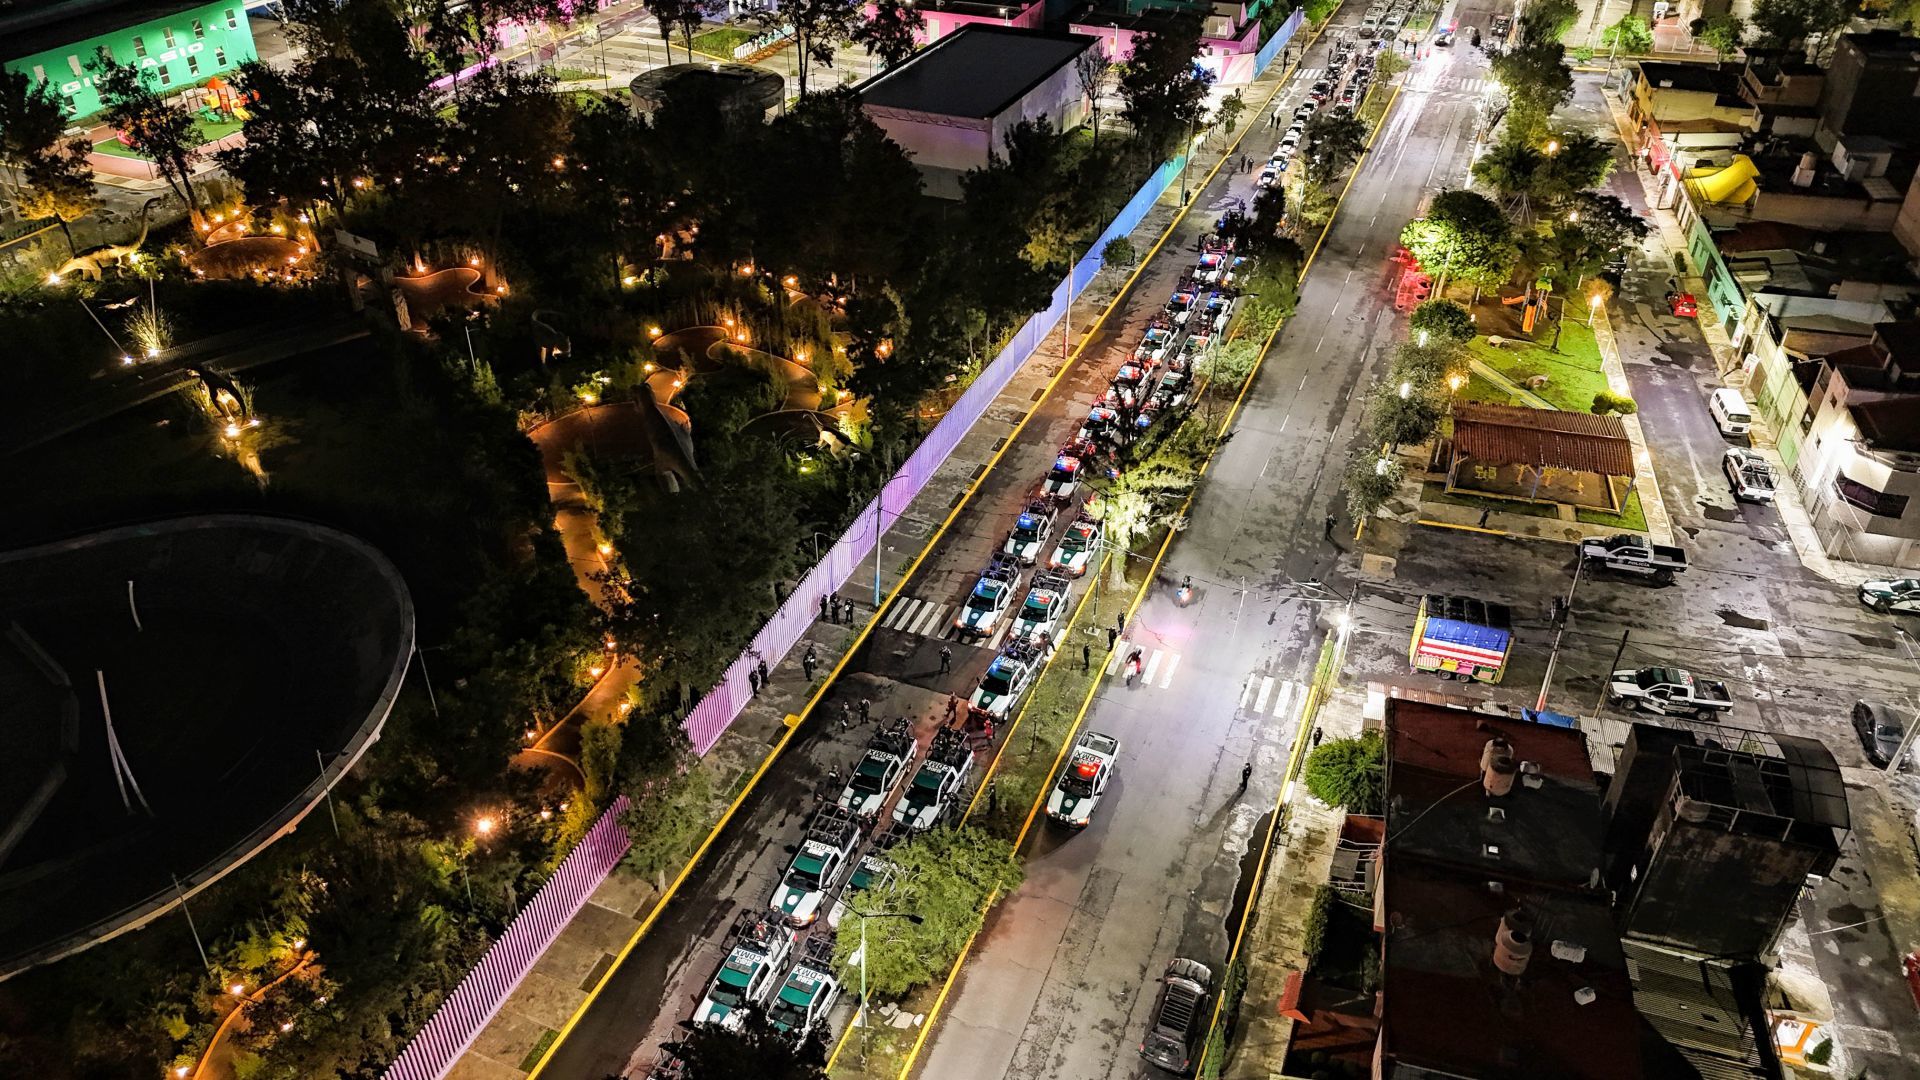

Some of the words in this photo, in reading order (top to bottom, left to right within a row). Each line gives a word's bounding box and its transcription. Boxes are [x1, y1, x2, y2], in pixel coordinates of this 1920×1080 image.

[1075, 750, 1102, 763] CDMX
[806, 840, 833, 853] CDMX
[733, 948, 763, 963] CDMX
[794, 966, 825, 982] CDMX
